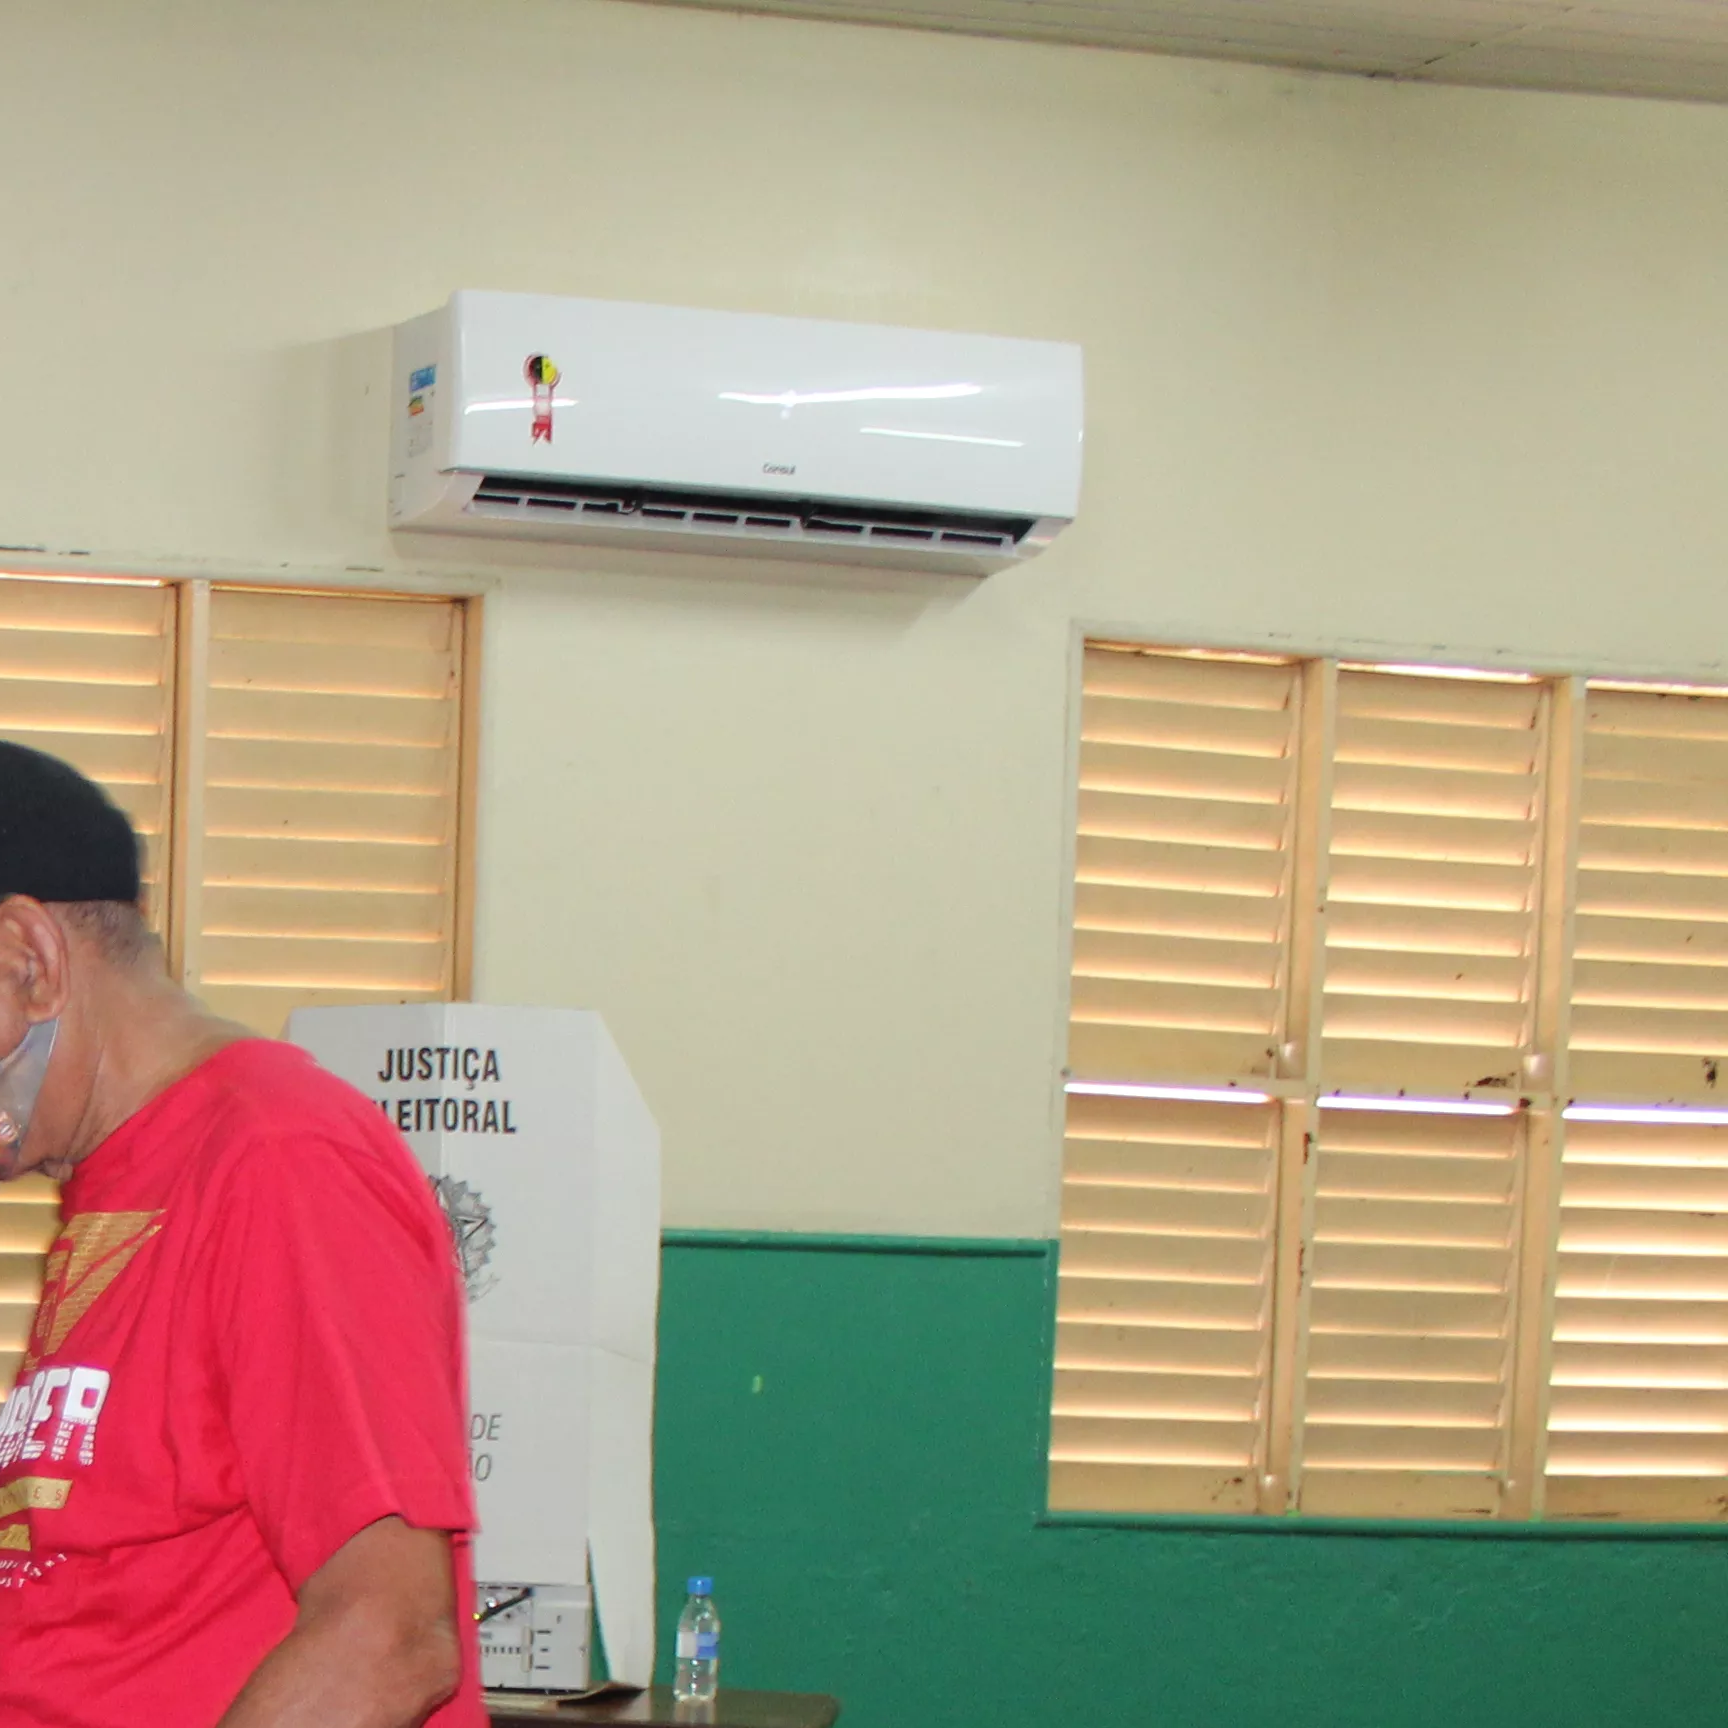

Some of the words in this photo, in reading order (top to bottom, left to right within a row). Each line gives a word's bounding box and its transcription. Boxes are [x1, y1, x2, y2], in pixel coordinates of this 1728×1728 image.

[377, 1047, 501, 1090] JUSTIÇA
[373, 1098, 517, 1134] EITORAL
[471, 1414, 501, 1441] DE
